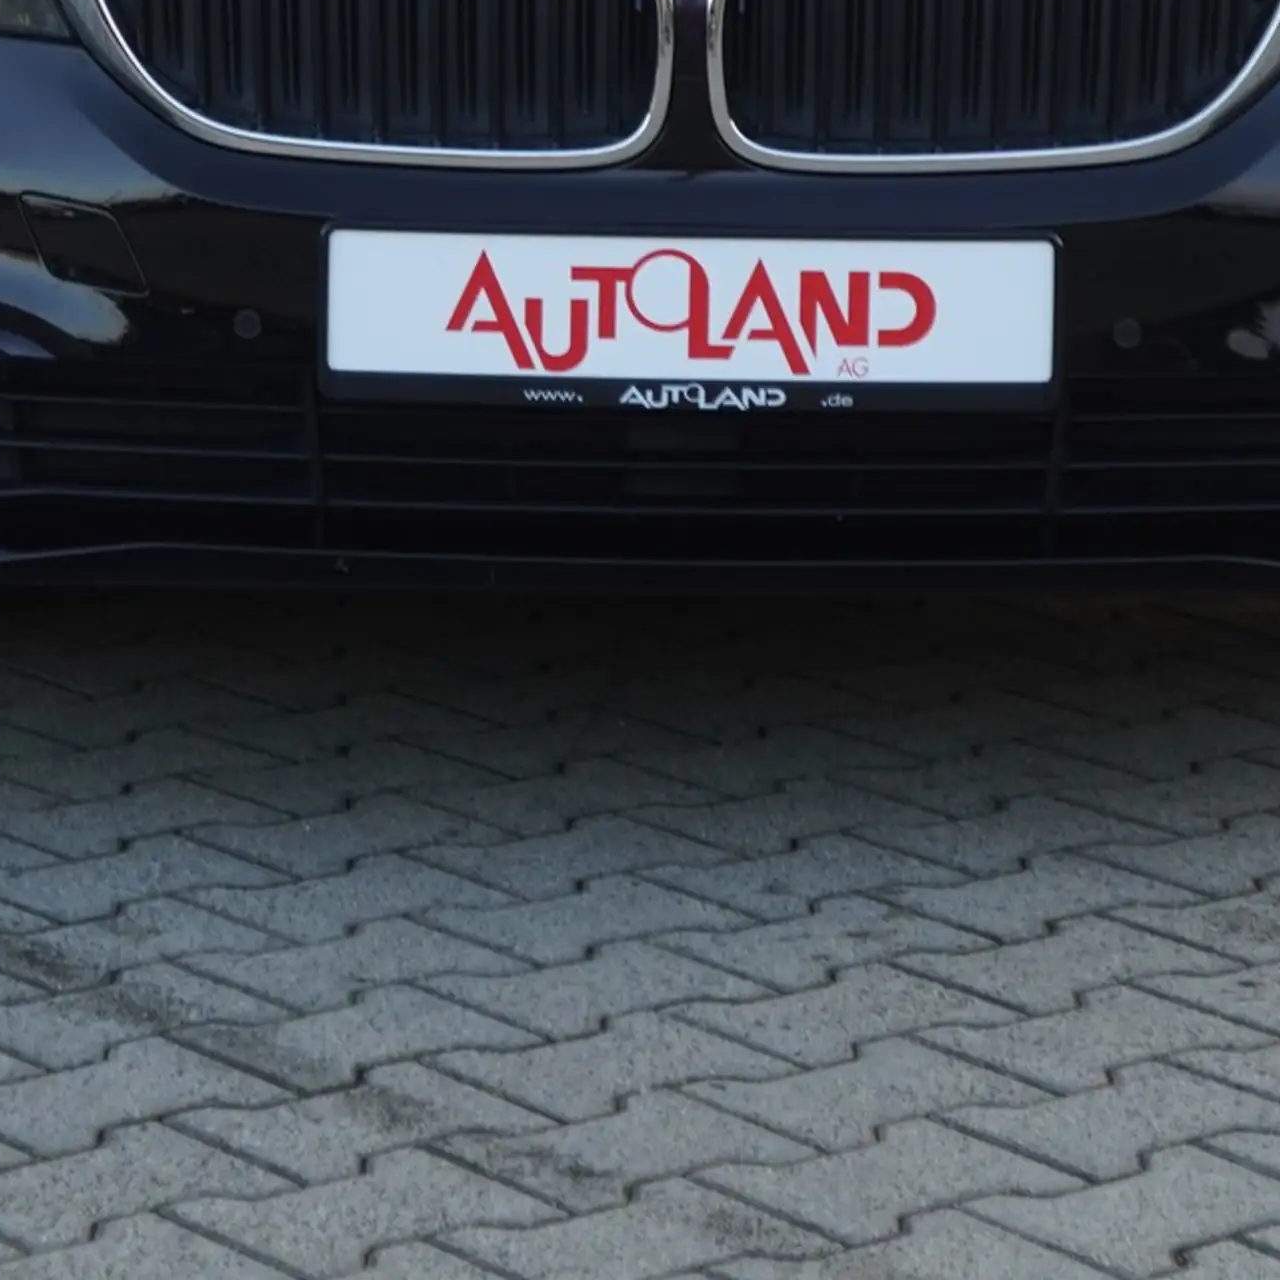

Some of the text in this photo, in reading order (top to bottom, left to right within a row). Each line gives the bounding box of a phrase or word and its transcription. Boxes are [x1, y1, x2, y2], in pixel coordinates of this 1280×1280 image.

[446, 248, 937, 376] AUTOLAND
[838, 356, 869, 379] AG
[523, 382, 853, 411] www. AUTOLAND .de
